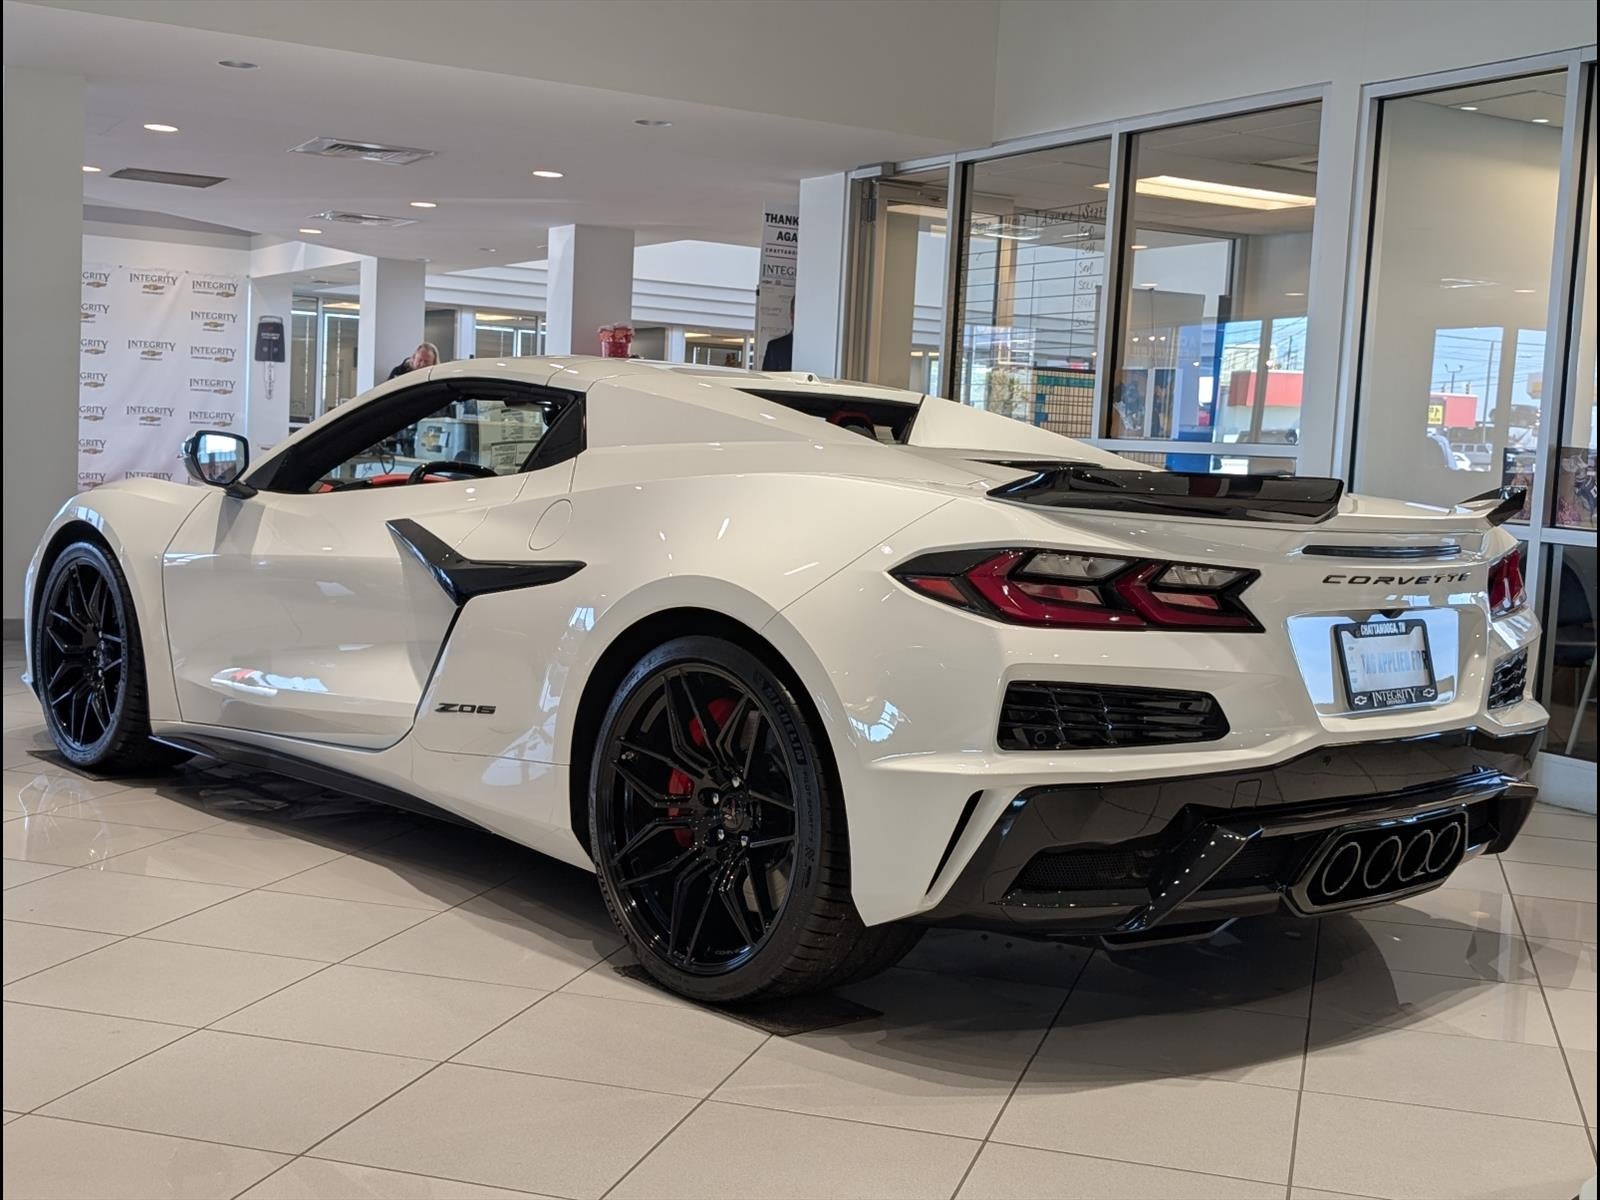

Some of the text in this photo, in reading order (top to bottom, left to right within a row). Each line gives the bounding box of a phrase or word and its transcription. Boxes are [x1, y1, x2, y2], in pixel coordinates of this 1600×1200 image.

[765, 213, 799, 226] THANK
[776, 231, 798, 242] AGA
[129, 272, 178, 286] INTEGRITY
[192, 279, 239, 292] INTEGRITY
[190, 310, 238, 323] INTEGRITY
[127, 339, 176, 352] INTEGRITY
[190, 345, 237, 358] INTEGRITY
[189, 377, 236, 390] INTEGRITY
[126, 405, 175, 418] INTEGRITY
[189, 410, 235, 423] INTEGRITY
[1322, 572, 1471, 586] CORVETTE
[1360, 622, 1406, 636] CHATTANOOGA, TN
[1378, 650, 1411, 673] APPLIED
[1371, 687, 1417, 707] INTEGRITY
[434, 703, 497, 715] Z06
[766, 686, 805, 761] MICHELIN
